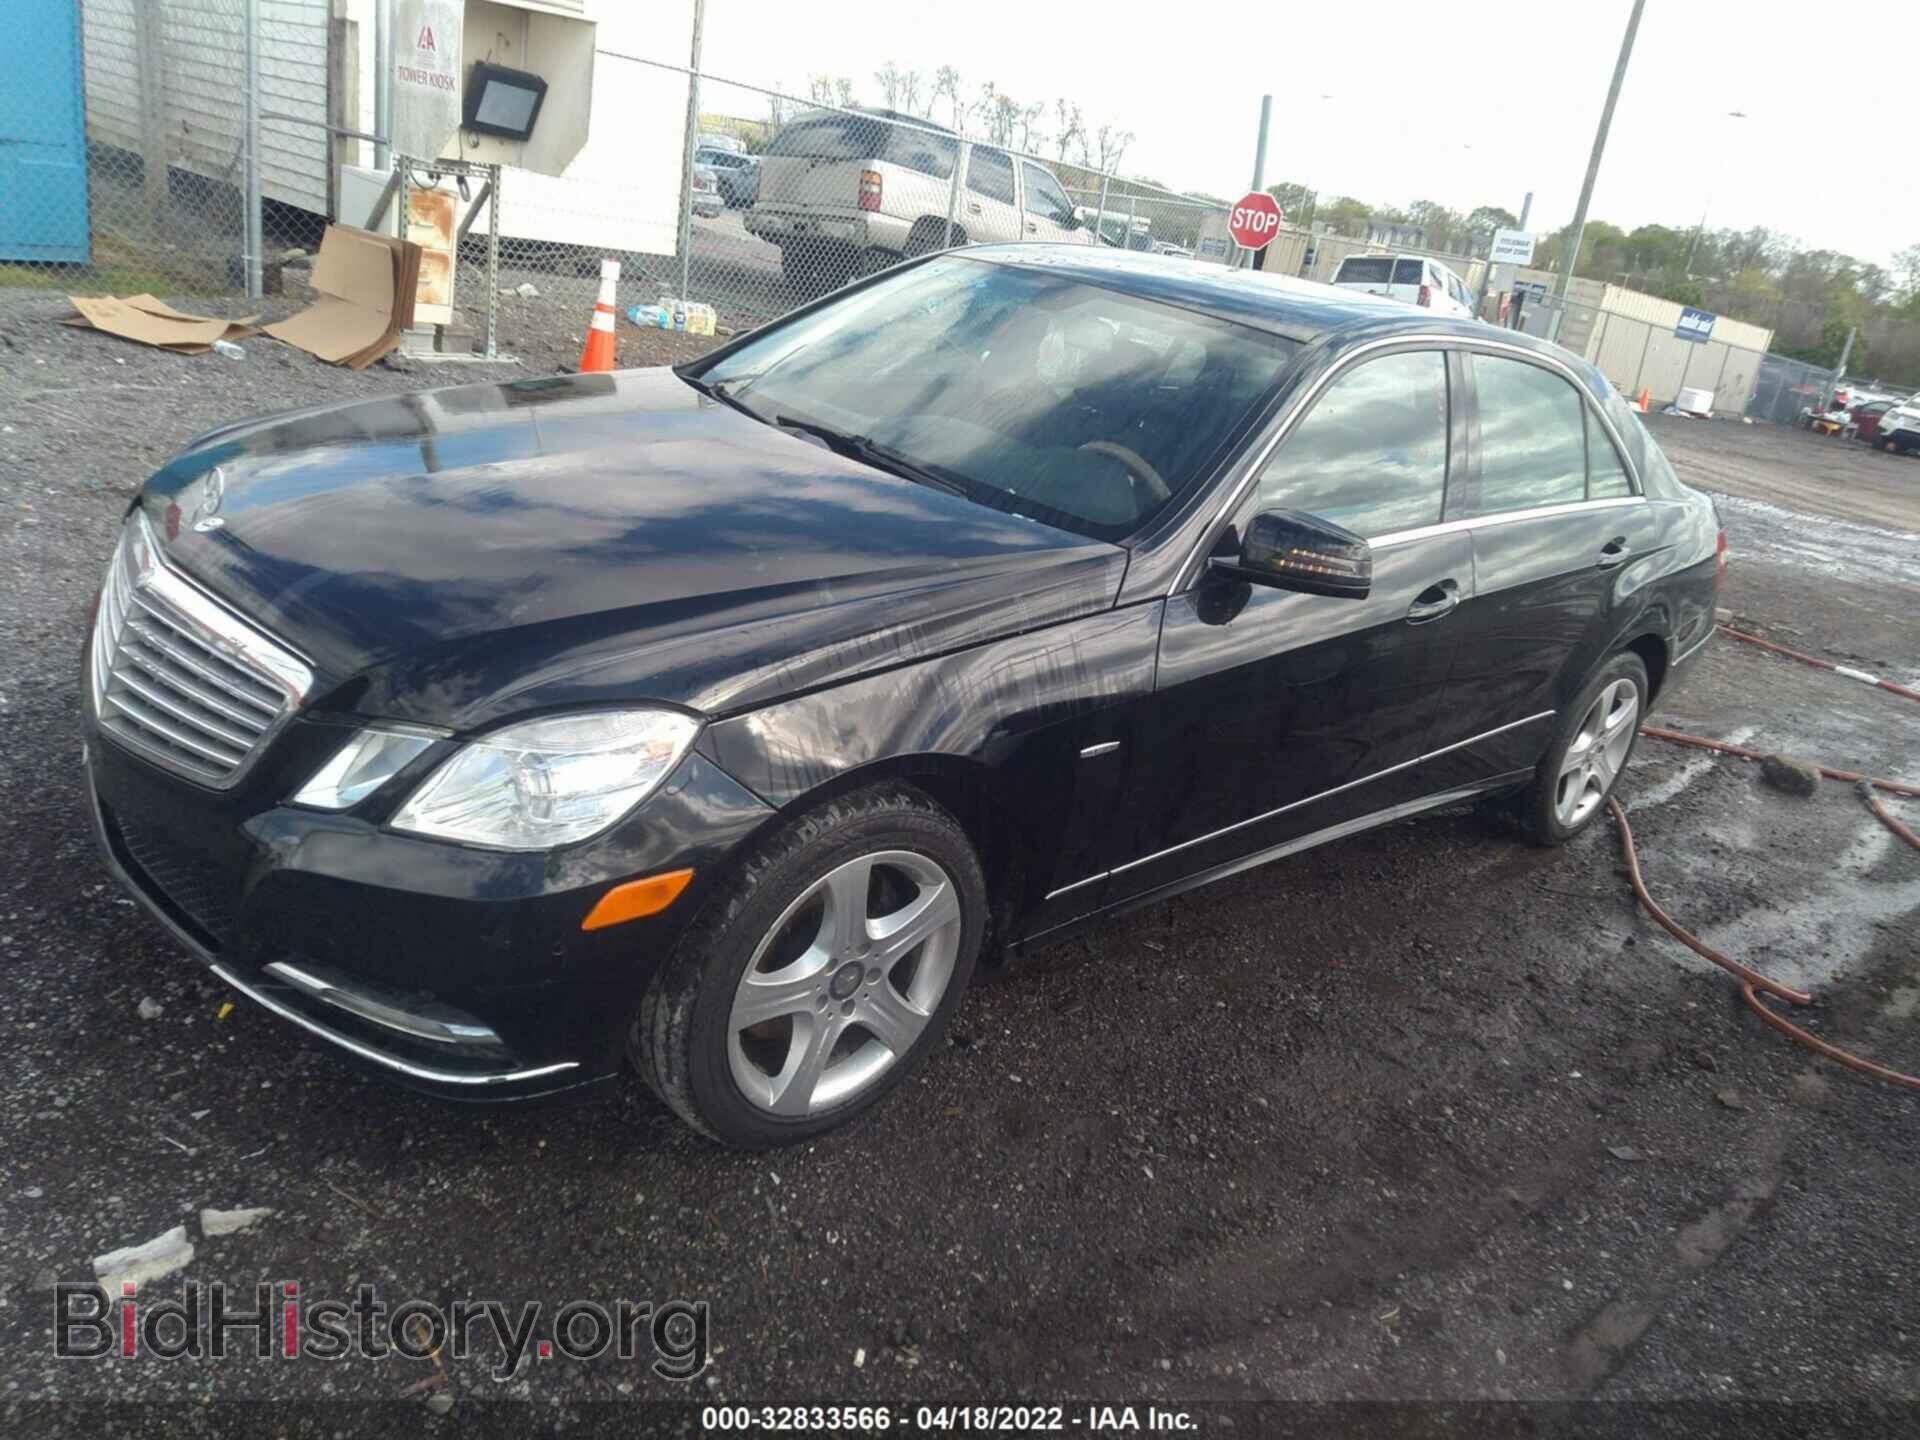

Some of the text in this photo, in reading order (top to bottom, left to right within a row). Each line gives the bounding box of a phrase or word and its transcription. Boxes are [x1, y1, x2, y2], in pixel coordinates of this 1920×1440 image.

[398, 65, 456, 92] TOWER KIOSK
[1232, 207, 1278, 233] STOP
